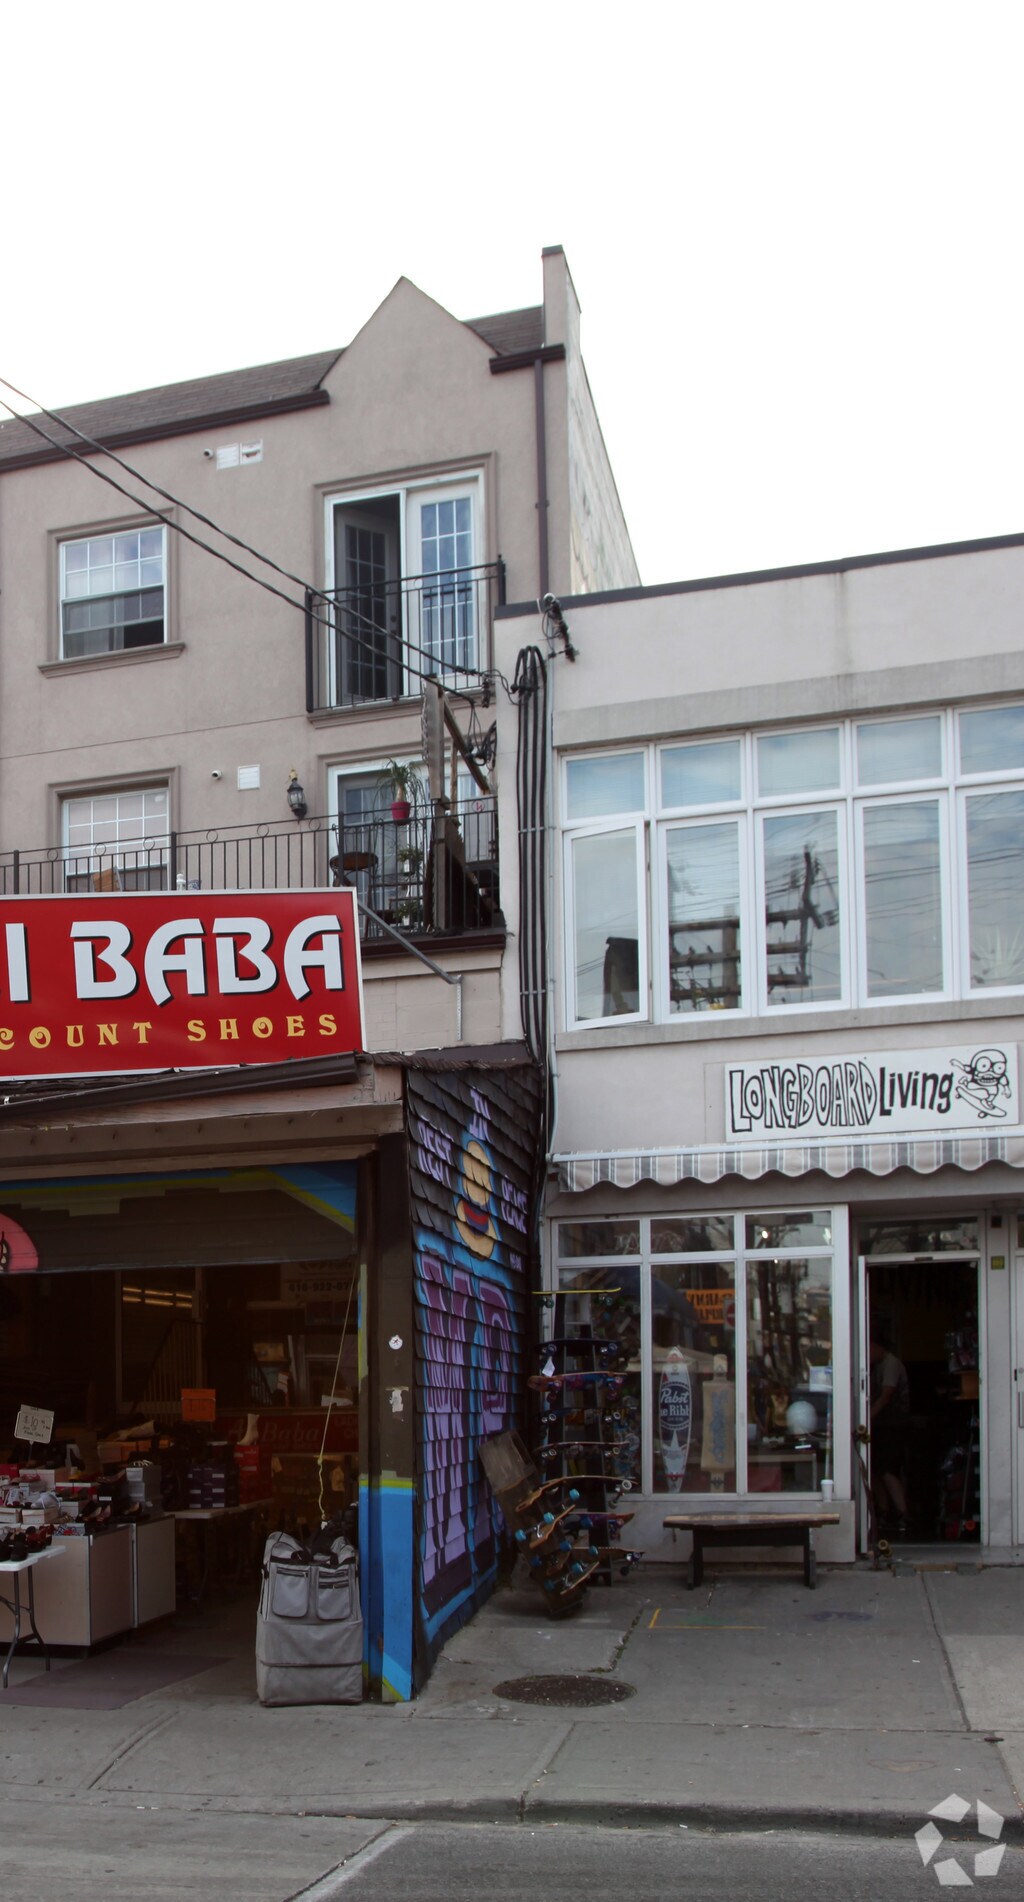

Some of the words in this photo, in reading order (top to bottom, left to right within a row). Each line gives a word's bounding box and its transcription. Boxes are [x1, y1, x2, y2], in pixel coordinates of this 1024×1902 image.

[70, 915, 345, 1007] BABA
[187, 1014, 338, 1042] SHOES
[729, 1060, 877, 1133] LONGBOARD
[879, 1066, 954, 1116] Living
[660, 1387, 690, 1404] Pabst
